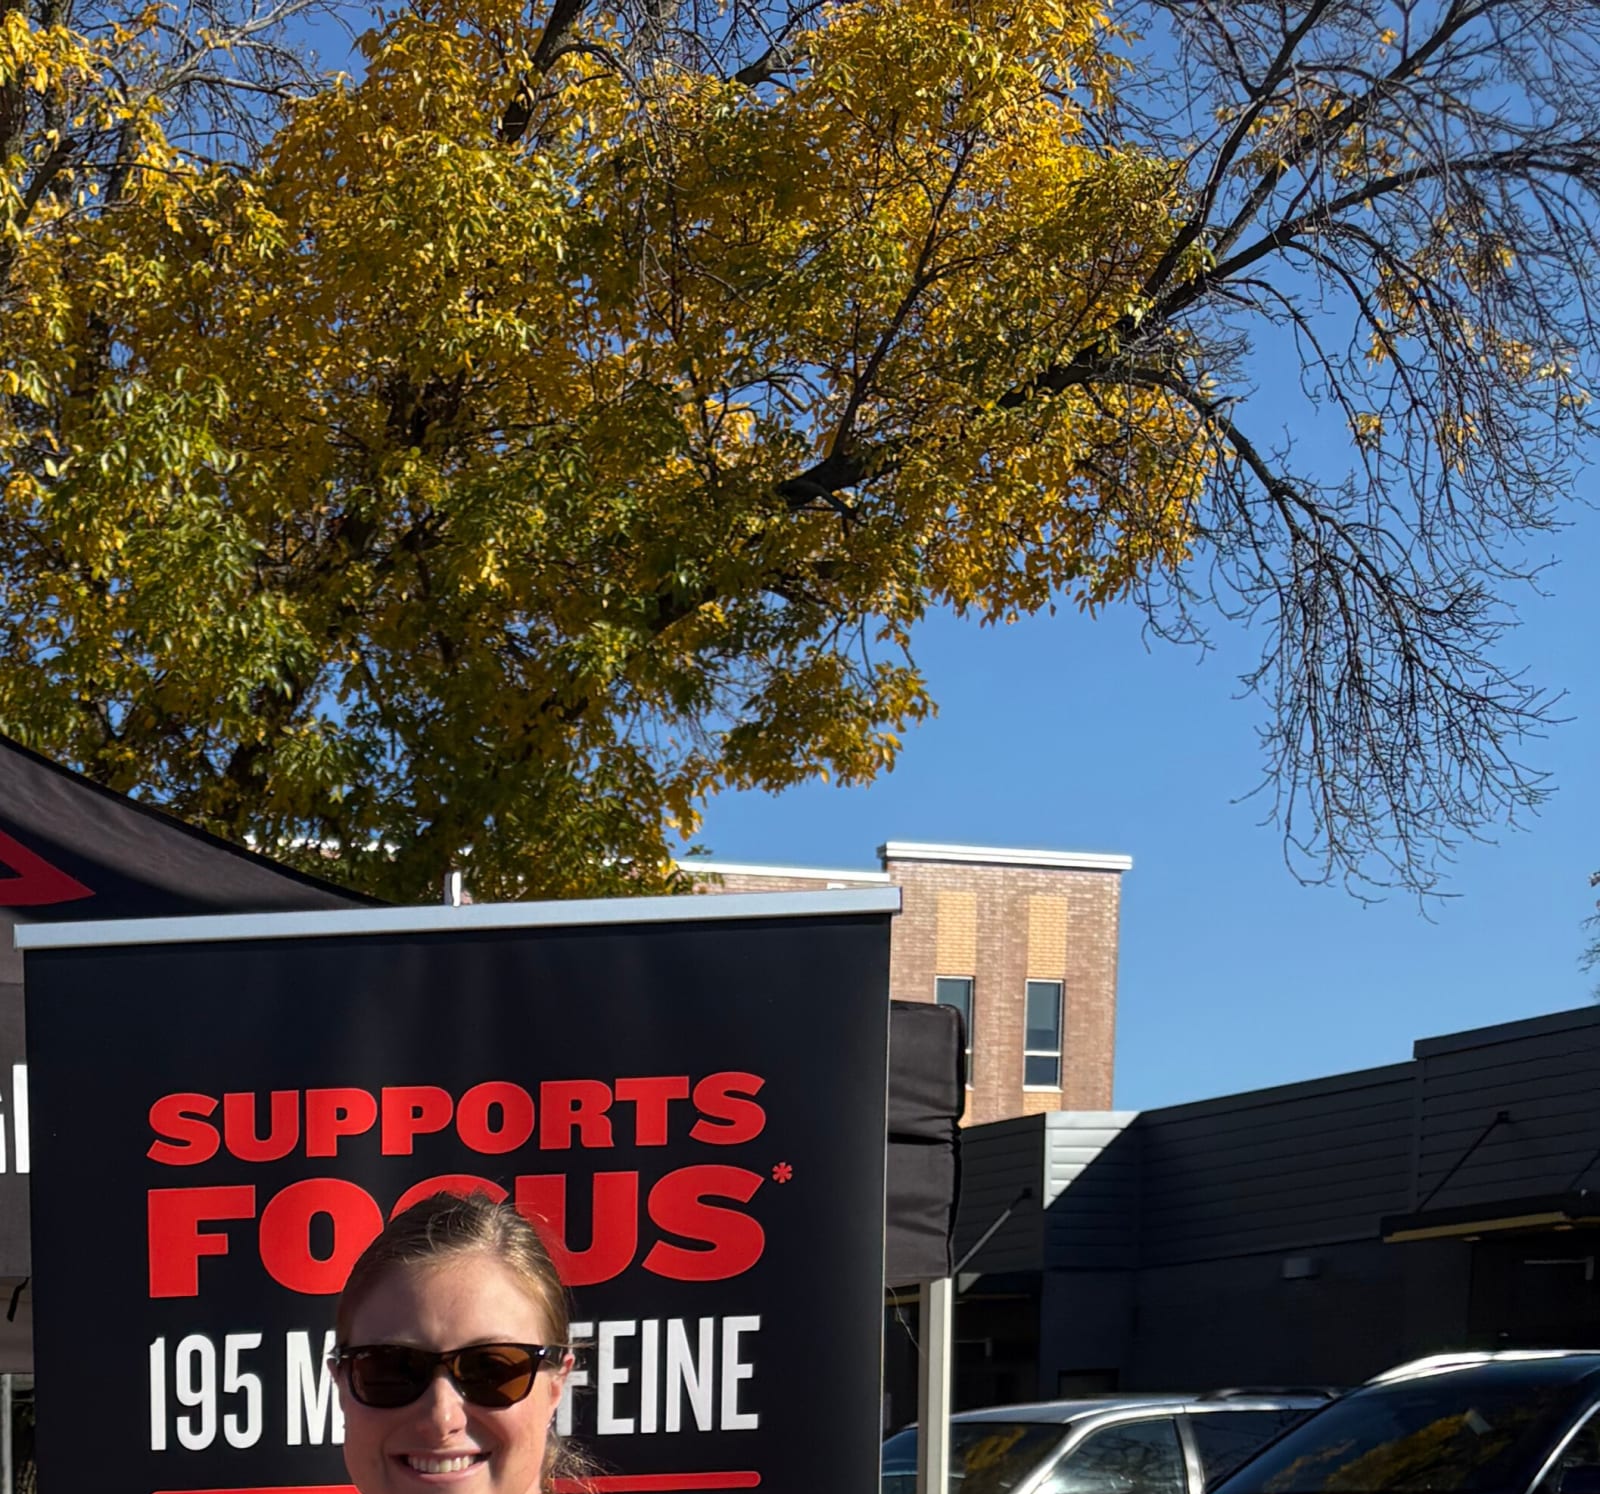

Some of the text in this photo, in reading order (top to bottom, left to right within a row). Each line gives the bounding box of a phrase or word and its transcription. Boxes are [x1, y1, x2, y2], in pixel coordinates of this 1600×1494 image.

[147, 1071, 767, 1166] SUPPORTS
[148, 1162, 794, 1298] FOUS
[149, 1314, 761, 1451] 195 M FEINE
